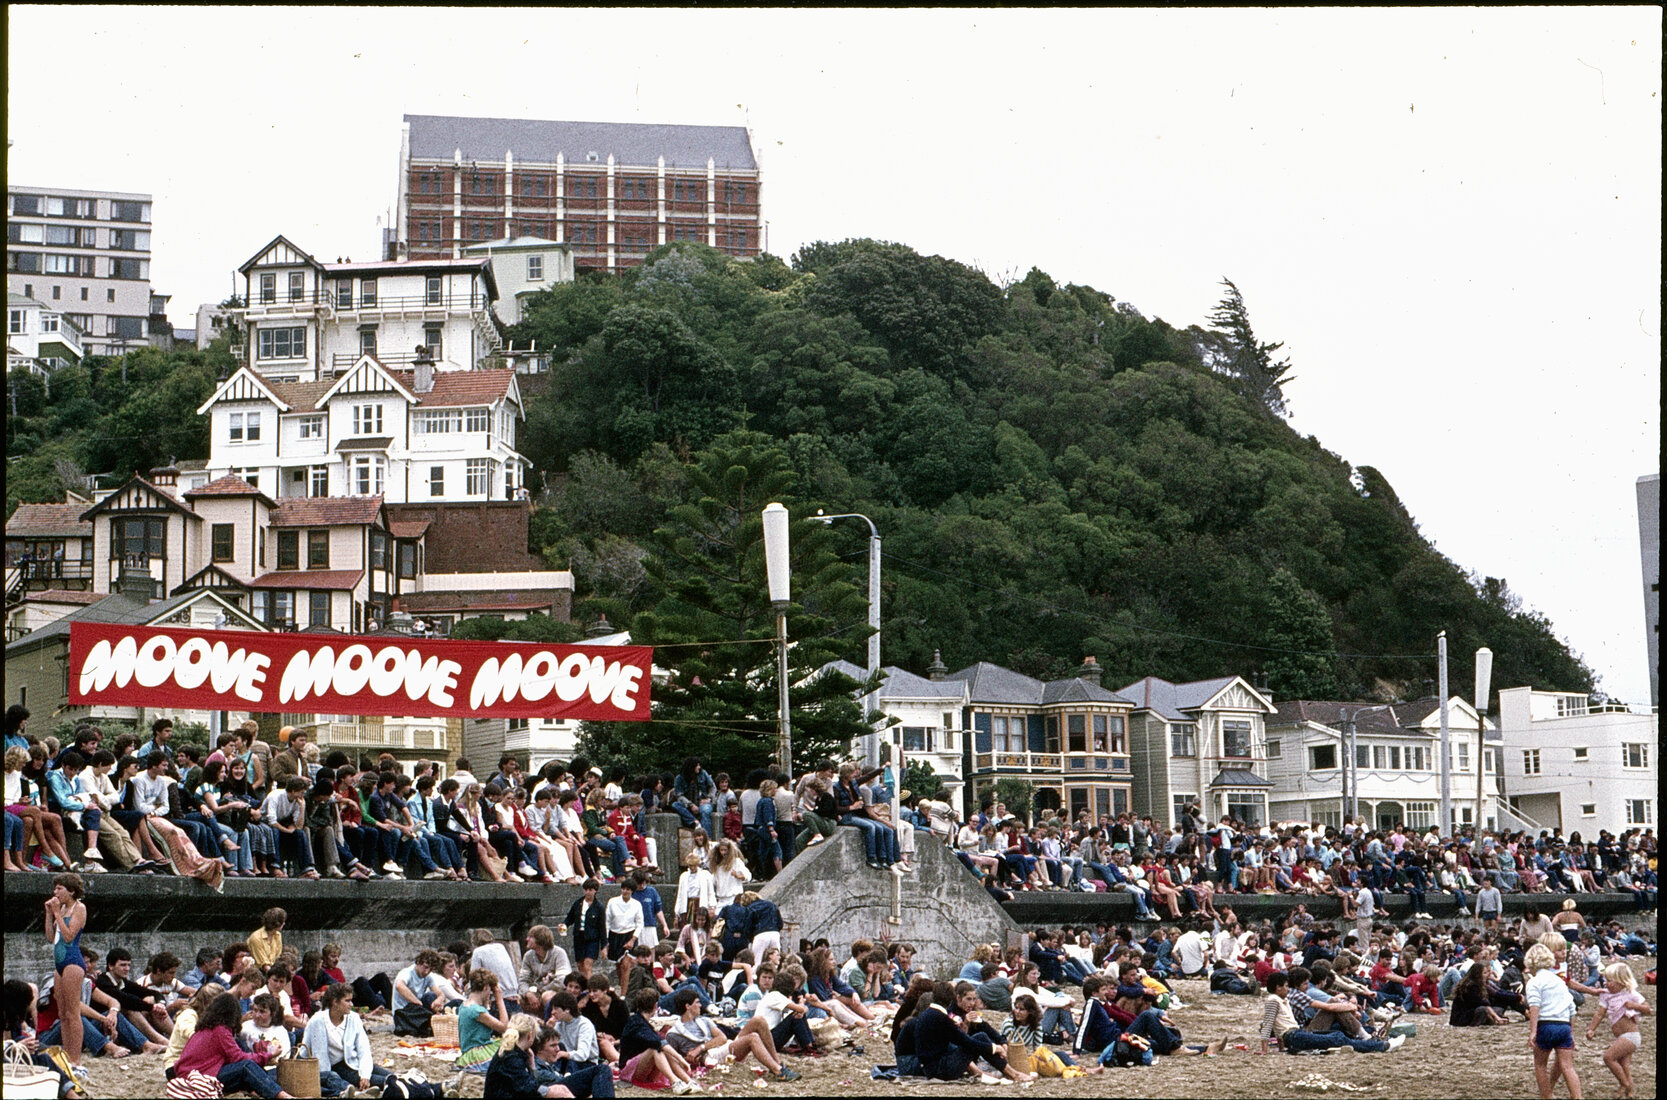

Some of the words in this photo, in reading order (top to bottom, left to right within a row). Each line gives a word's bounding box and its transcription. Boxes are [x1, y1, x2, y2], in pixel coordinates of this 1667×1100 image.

[79, 635, 272, 703] MOOVE
[279, 644, 462, 708] MOOVE
[469, 651, 644, 712] MOOVE
